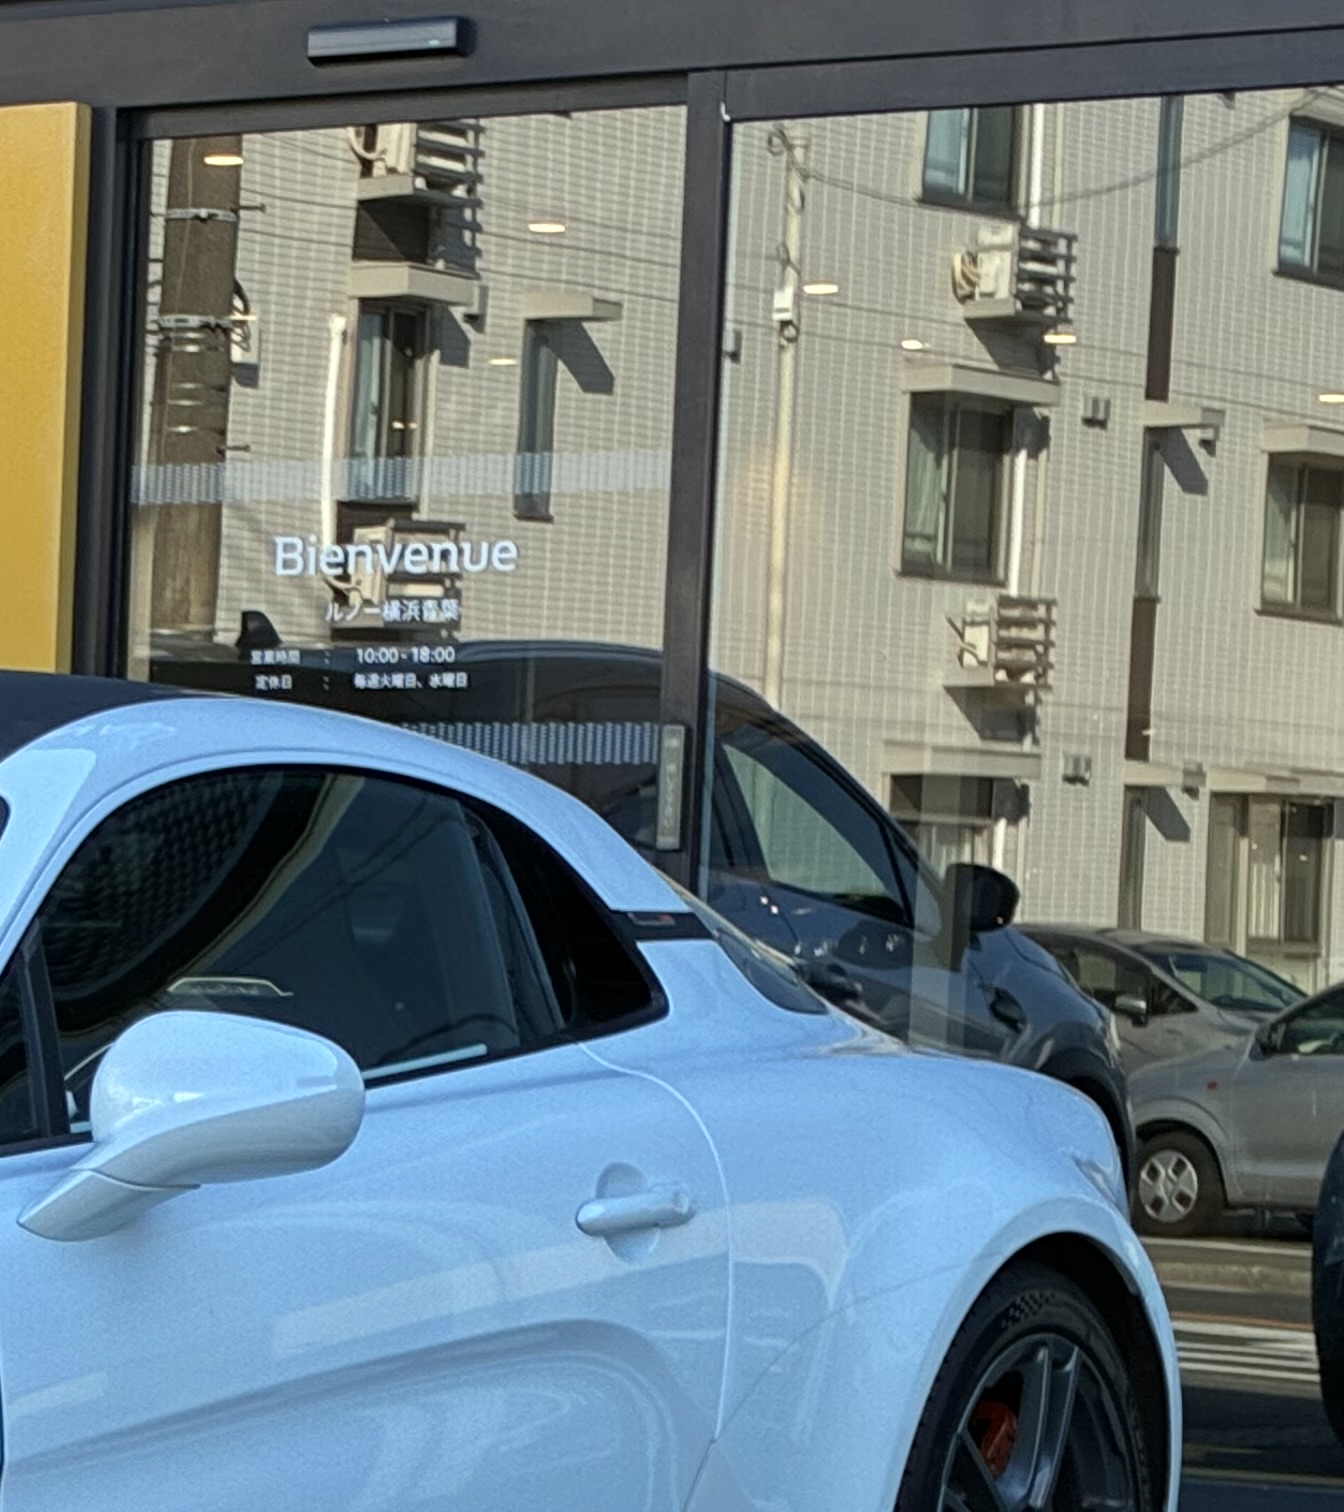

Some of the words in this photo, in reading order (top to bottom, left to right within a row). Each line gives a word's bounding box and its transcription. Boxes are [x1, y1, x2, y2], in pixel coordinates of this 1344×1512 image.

[273, 535, 518, 576] Bienvenue
[324, 600, 461, 623] ルノー横浜青葉
[254, 674, 293, 690] 定休日
